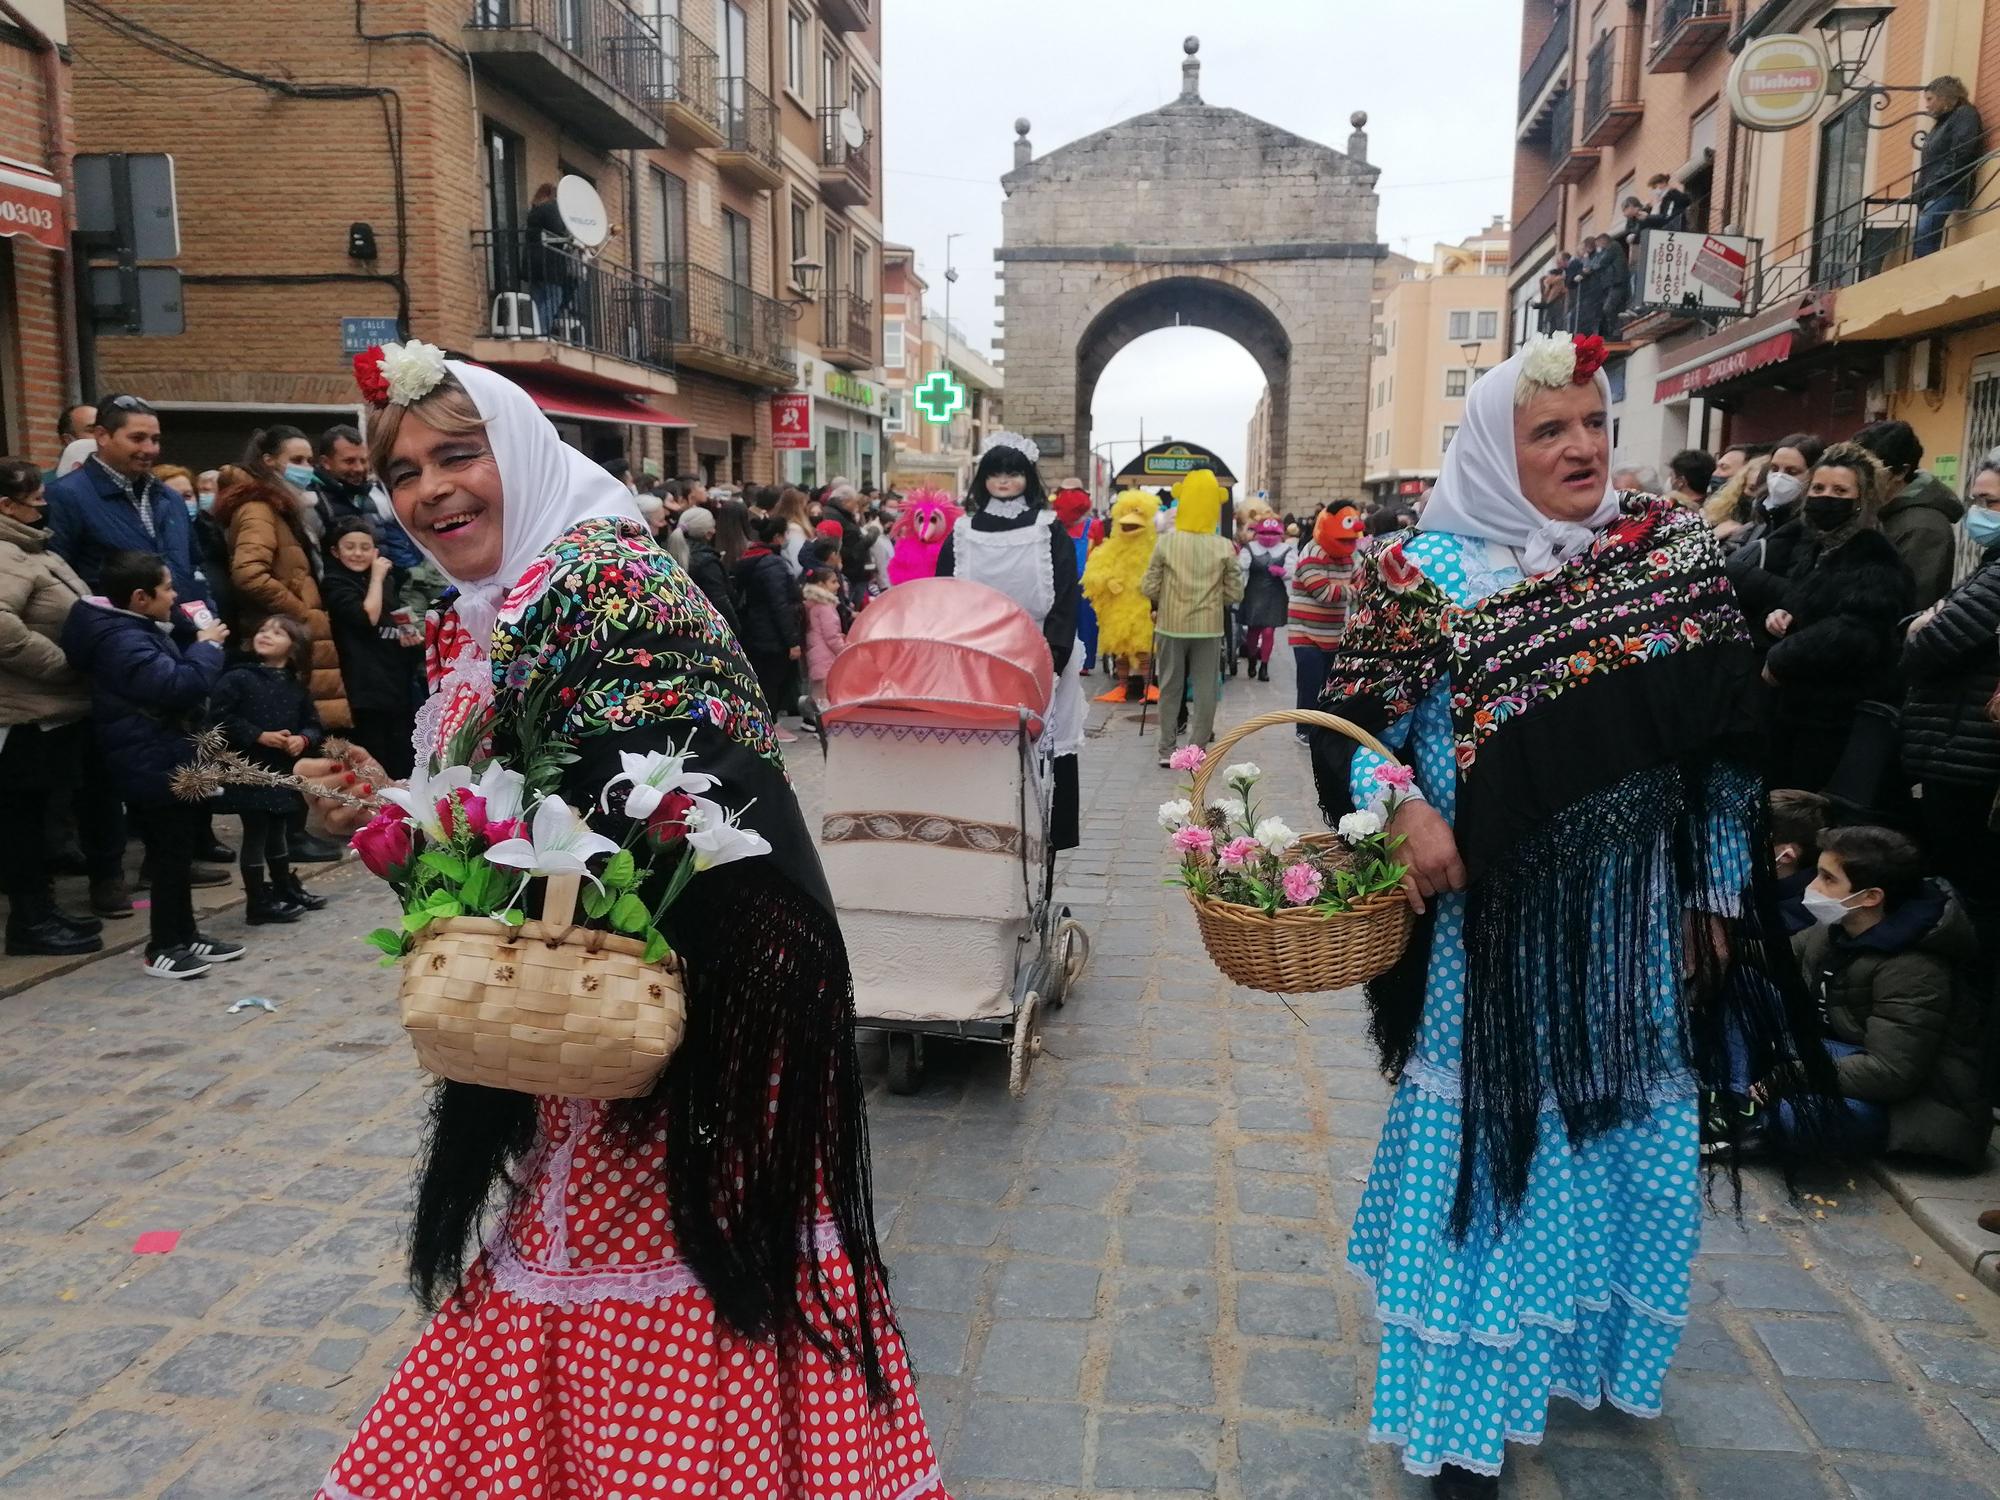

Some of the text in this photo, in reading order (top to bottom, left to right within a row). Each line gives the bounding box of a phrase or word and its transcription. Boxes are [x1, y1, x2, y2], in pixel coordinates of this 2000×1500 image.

[1748, 74, 1812, 91] Mahou
[0, 200, 53, 230] 0303
[1705, 238, 1727, 256] BAR
[1655, 243, 1665, 295] ZODIACO
[1662, 232, 1675, 304] ZODIACO
[1673, 244, 1683, 297] ZODIACO
[361, 320, 386, 329] CALLE
